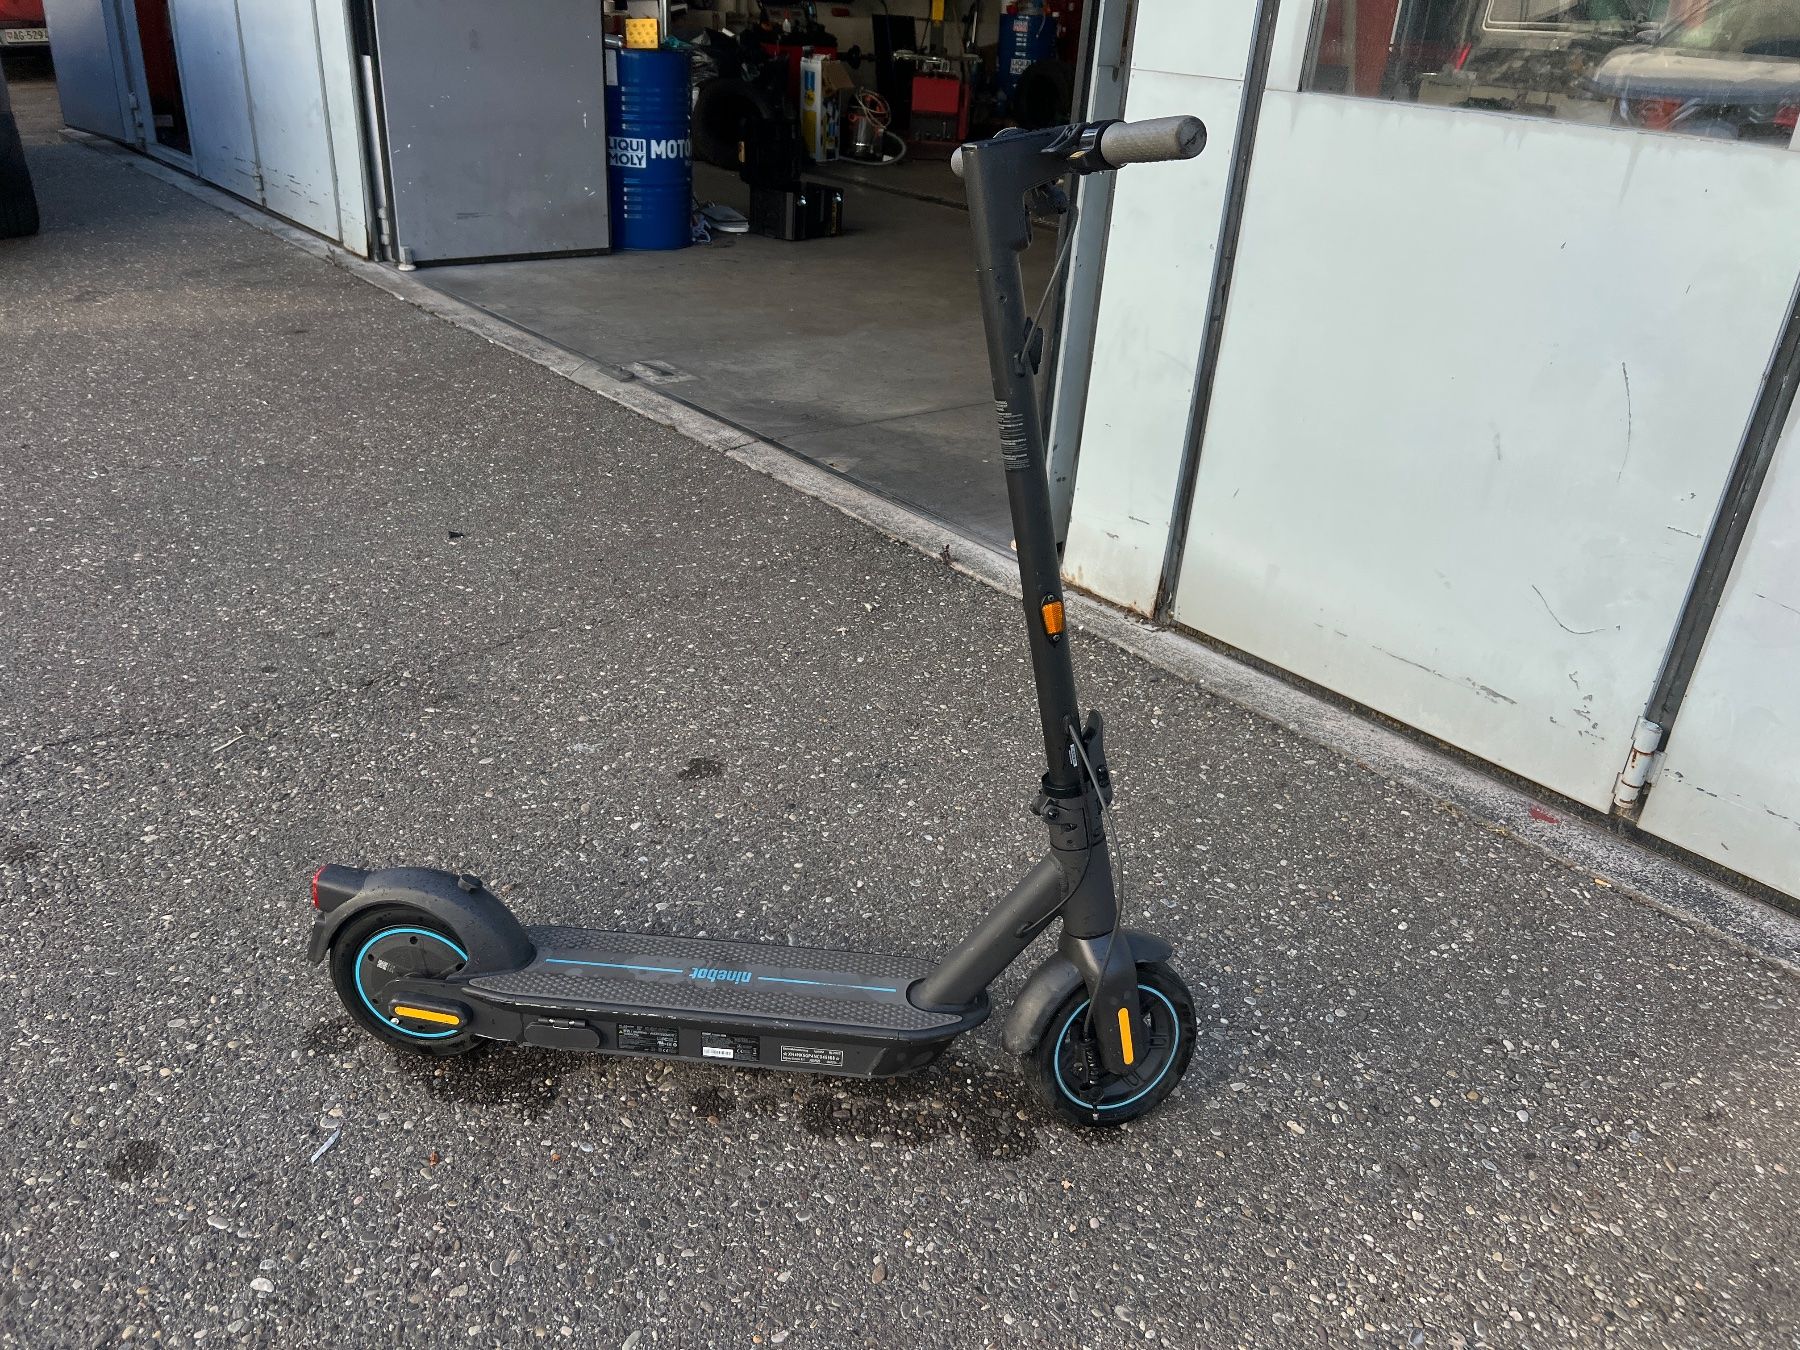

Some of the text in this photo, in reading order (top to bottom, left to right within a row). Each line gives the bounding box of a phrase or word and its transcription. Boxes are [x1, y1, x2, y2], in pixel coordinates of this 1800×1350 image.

[650, 139, 692, 159] MOTO
[608, 152, 644, 166] MOLY
[689, 967, 752, 984] ninebot
